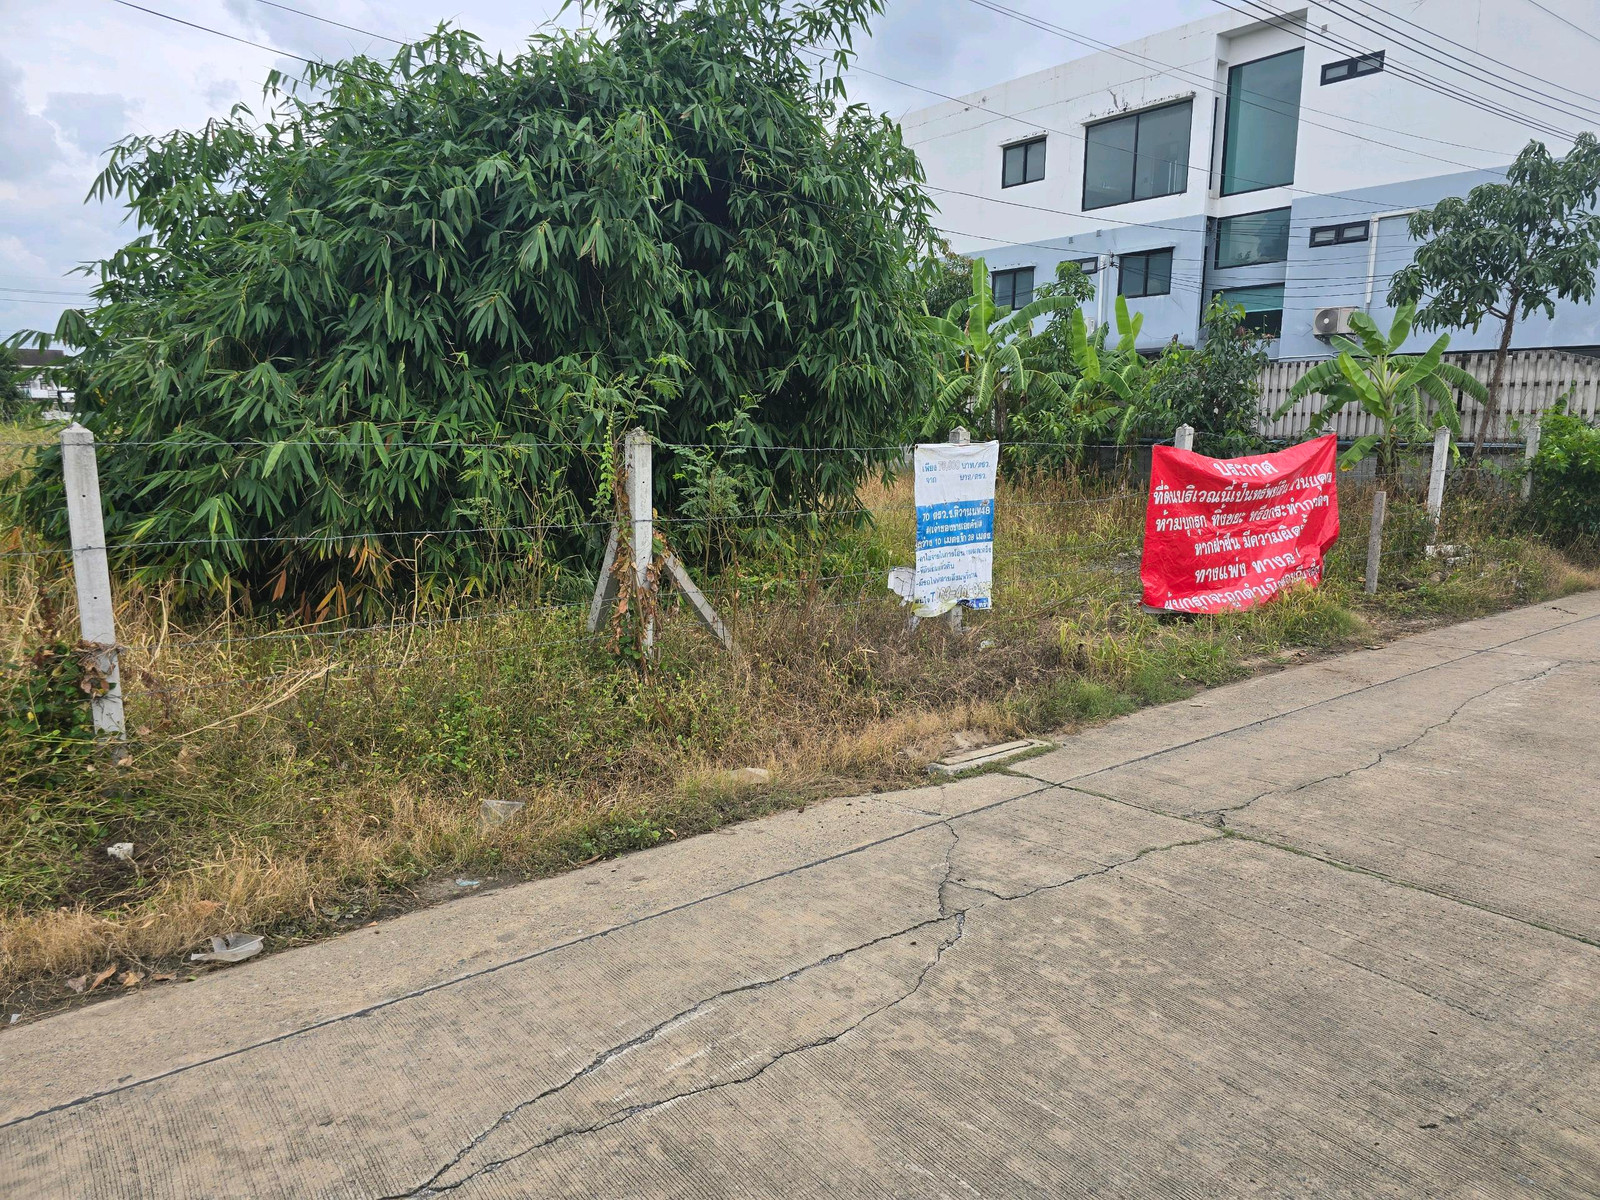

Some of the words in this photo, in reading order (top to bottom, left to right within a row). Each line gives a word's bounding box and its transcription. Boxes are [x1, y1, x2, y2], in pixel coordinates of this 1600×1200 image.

[1213, 460, 1279, 477] ประกาศ
[1194, 530, 1241, 556] หากฝ่าฝืน
[1194, 557, 1247, 584] ทางแพ่ง
